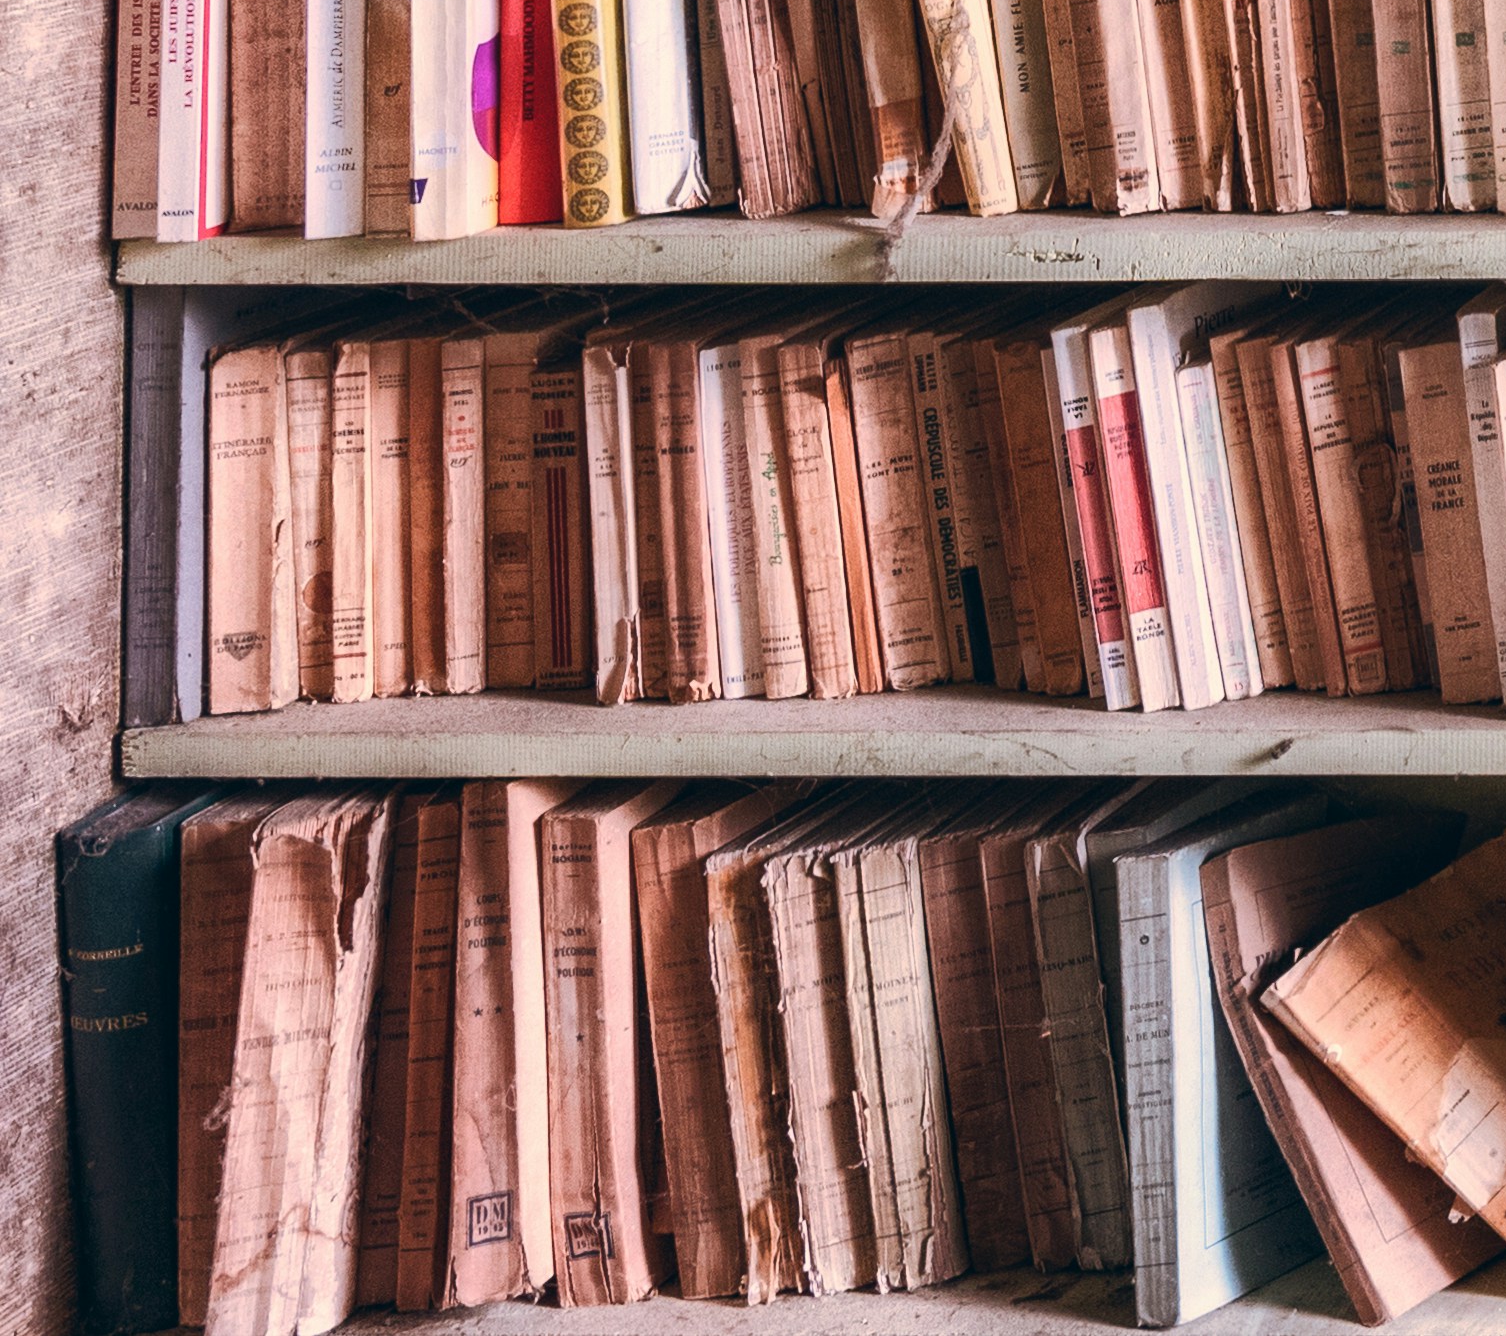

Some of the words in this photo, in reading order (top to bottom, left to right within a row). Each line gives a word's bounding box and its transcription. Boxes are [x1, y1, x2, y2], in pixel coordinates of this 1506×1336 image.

[1013, 21, 1026, 54] AMIE
[169, 40, 178, 64] LES
[1018, 61, 1030, 93] MON
[183, 91, 193, 108] LA
